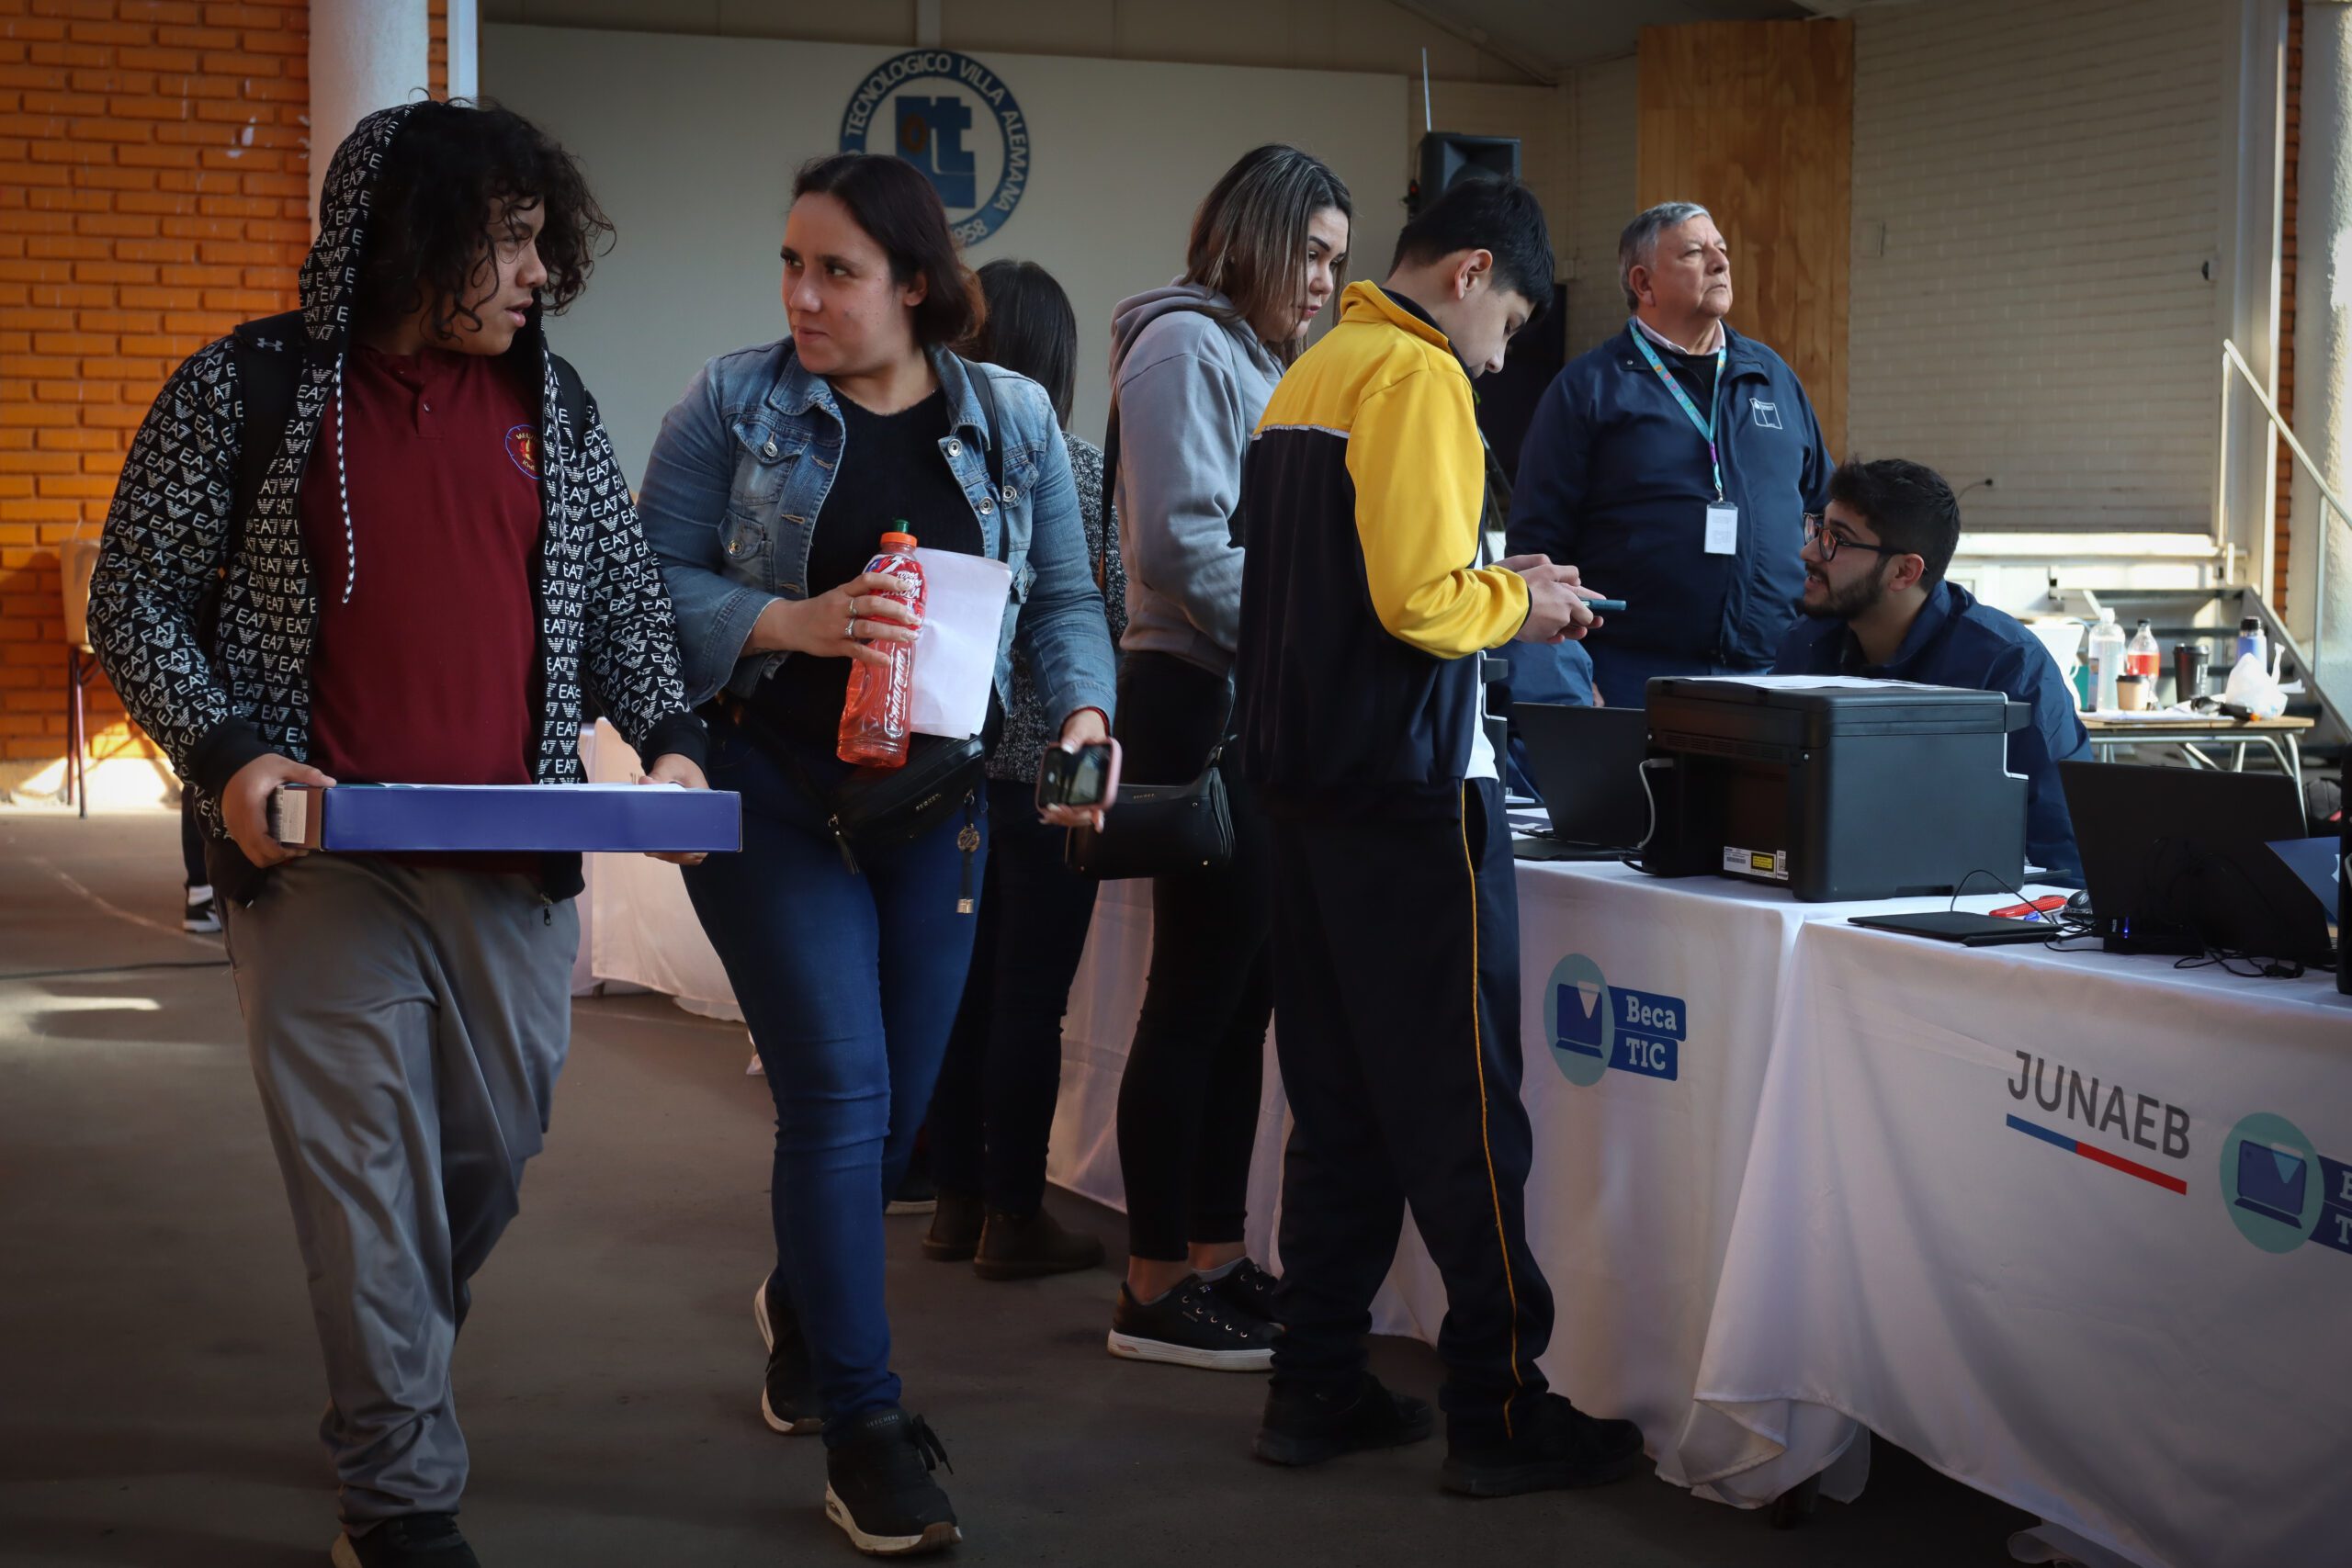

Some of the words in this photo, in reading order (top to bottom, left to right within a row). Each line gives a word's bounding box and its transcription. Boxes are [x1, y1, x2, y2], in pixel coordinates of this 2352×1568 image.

[844, 52, 953, 137] TECNOLOGICO
[958, 59, 1006, 107] VILLA
[993, 109, 1028, 212] ALEMANA
[953, 219, 988, 243] 958
[160, 416, 192, 439] EA7
[145, 450, 176, 474] EA7
[130, 486, 163, 507] EA7
[164, 481, 204, 506] EA7
[590, 495, 617, 518] EA7
[116, 521, 147, 540] EA7
[149, 514, 189, 538] EA7
[599, 530, 628, 553] EA7
[107, 553, 143, 570] EA7
[178, 544, 217, 564] EA7
[608, 562, 639, 581] EA7
[235, 608, 268, 628] EA7
[544, 618, 566, 634] EA7
[155, 649, 189, 670] EA7
[226, 645, 257, 665] EA7
[547, 657, 569, 671] EA7
[555, 759, 577, 773] EA7
[1625, 995, 1678, 1031] Beca
[1625, 1037, 1666, 1071] TIC
[2007, 1049, 2190, 1159] JUNAEB
